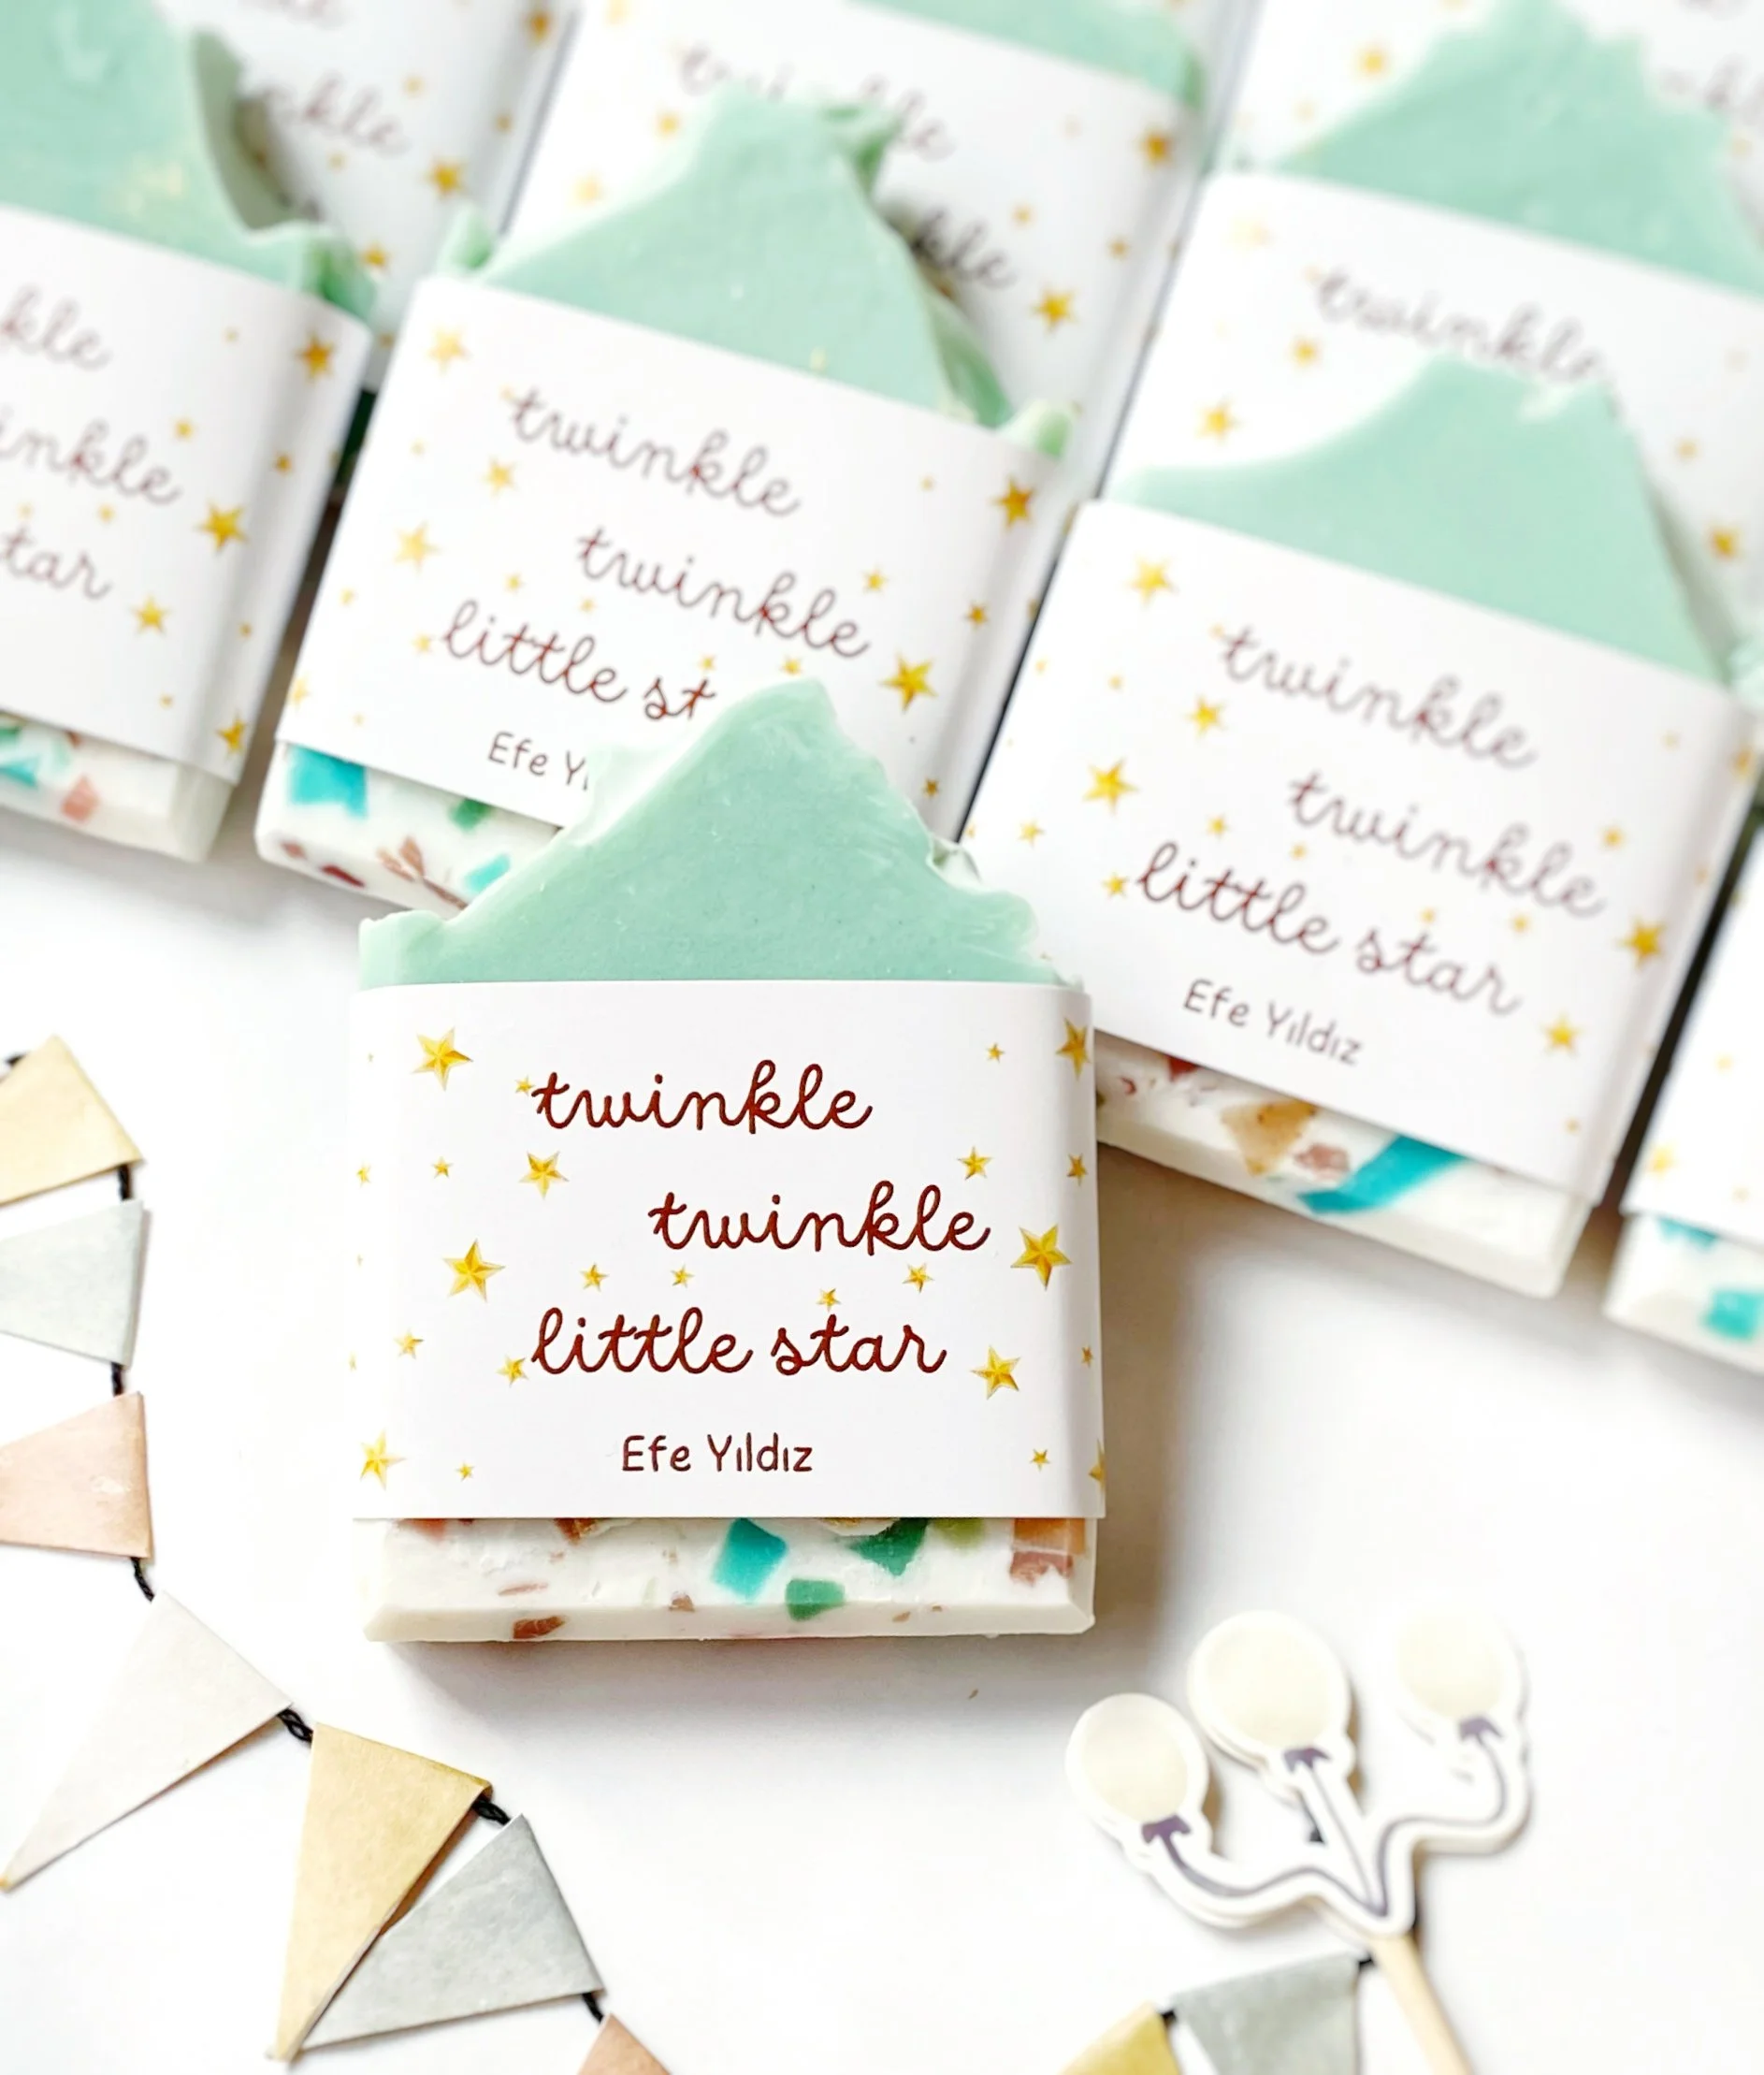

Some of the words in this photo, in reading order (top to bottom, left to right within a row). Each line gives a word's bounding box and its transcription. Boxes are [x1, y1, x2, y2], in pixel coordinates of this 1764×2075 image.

[508, 388, 802, 517] twinkle
[0, 525, 113, 601] tar
[576, 526, 872, 660] twinkle
[440, 598, 629, 705] little
[641, 675, 718, 723] st
[1217, 625, 1538, 770] twinkle
[486, 730, 550, 777] Efe
[1287, 770, 1606, 919] twinkle
[1135, 840, 1341, 956] little
[1354, 927, 1523, 1017] star
[1181, 977, 1251, 1029] Efe
[1265, 1000, 1365, 1067] Yıldız
[530, 1058, 875, 1136] twinkle
[646, 1178, 992, 1257] twinkle
[530, 1306, 755, 1376] little
[769, 1313, 948, 1377] star
[620, 1433, 692, 1473] Efe
[705, 1430, 814, 1473] Yıldız
